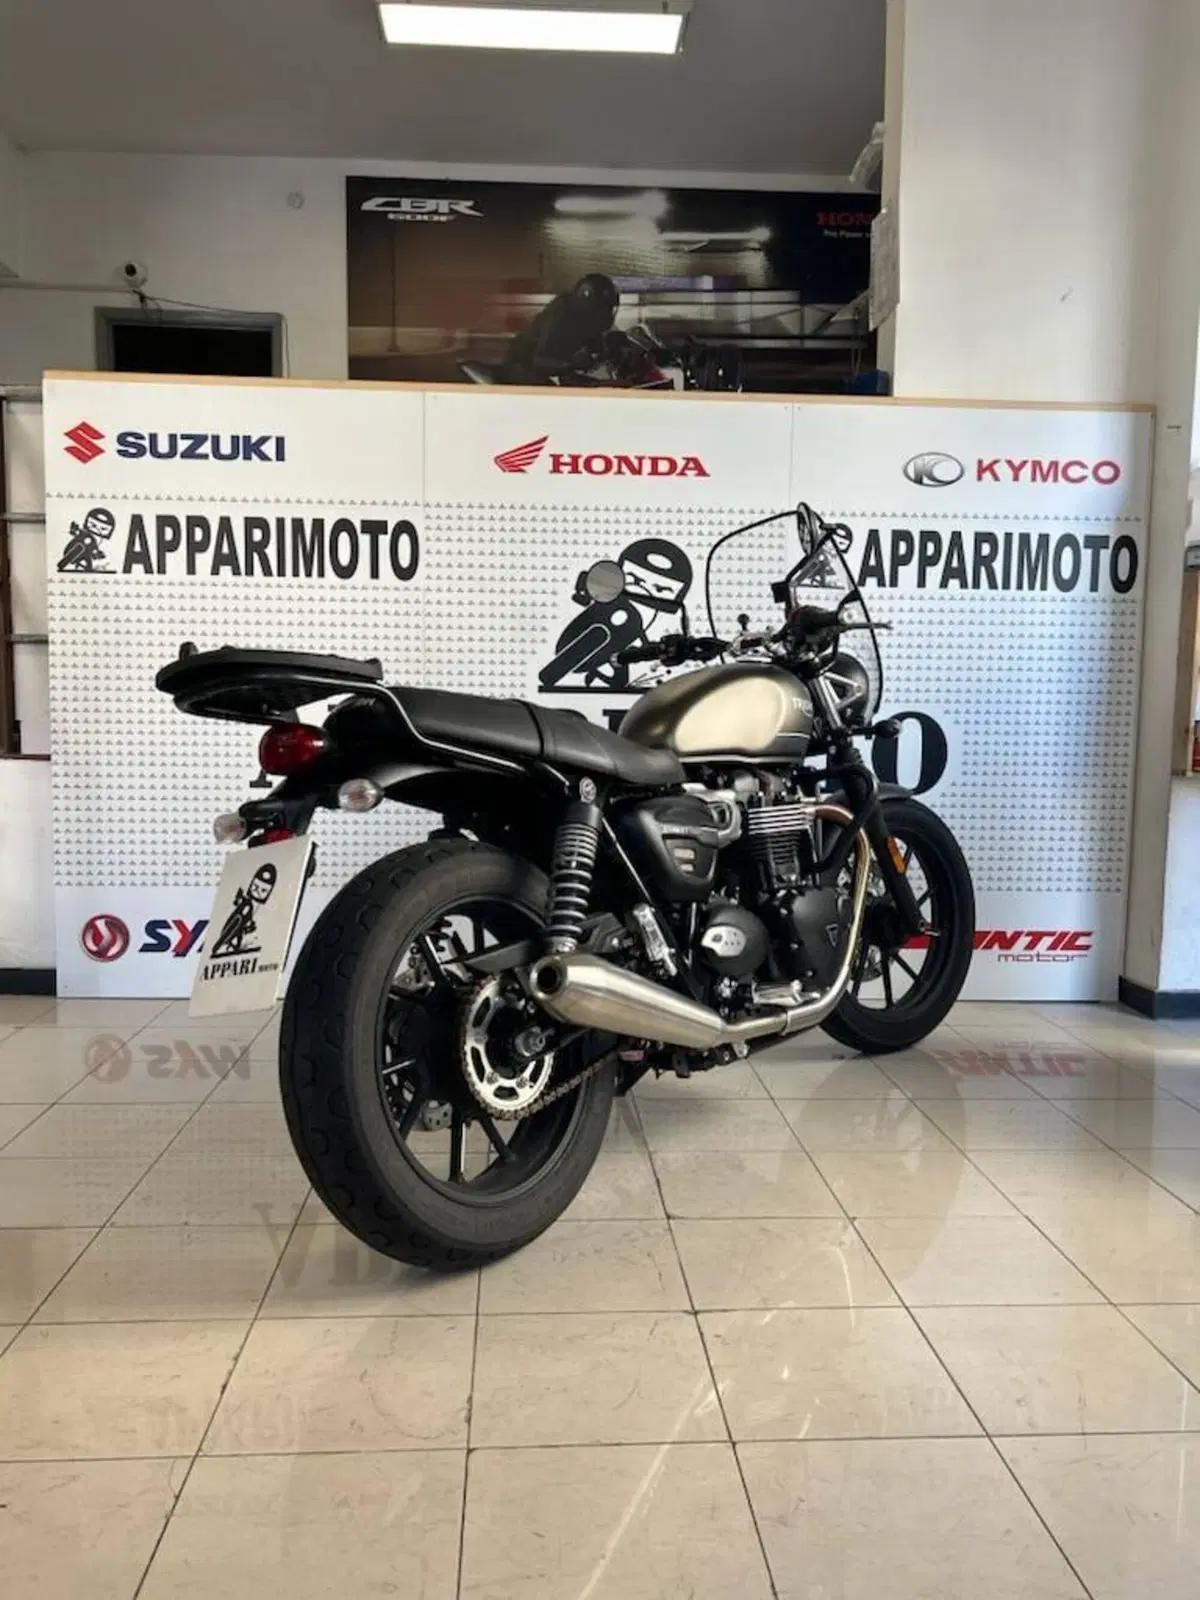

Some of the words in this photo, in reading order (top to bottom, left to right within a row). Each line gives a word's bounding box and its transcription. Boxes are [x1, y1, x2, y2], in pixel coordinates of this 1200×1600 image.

[361, 197, 484, 217] CBR
[816, 210, 873, 227] HON
[116, 430, 286, 462] SUZUKI
[549, 453, 711, 478] HONDA
[975, 458, 1121, 486] KYMCO
[122, 512, 420, 582] APPARIMOTO
[857, 527, 1139, 595] APPARIMOTO
[138, 919, 210, 957] SY
[202, 957, 258, 981] APPARI
[997, 951, 1089, 963] motor
